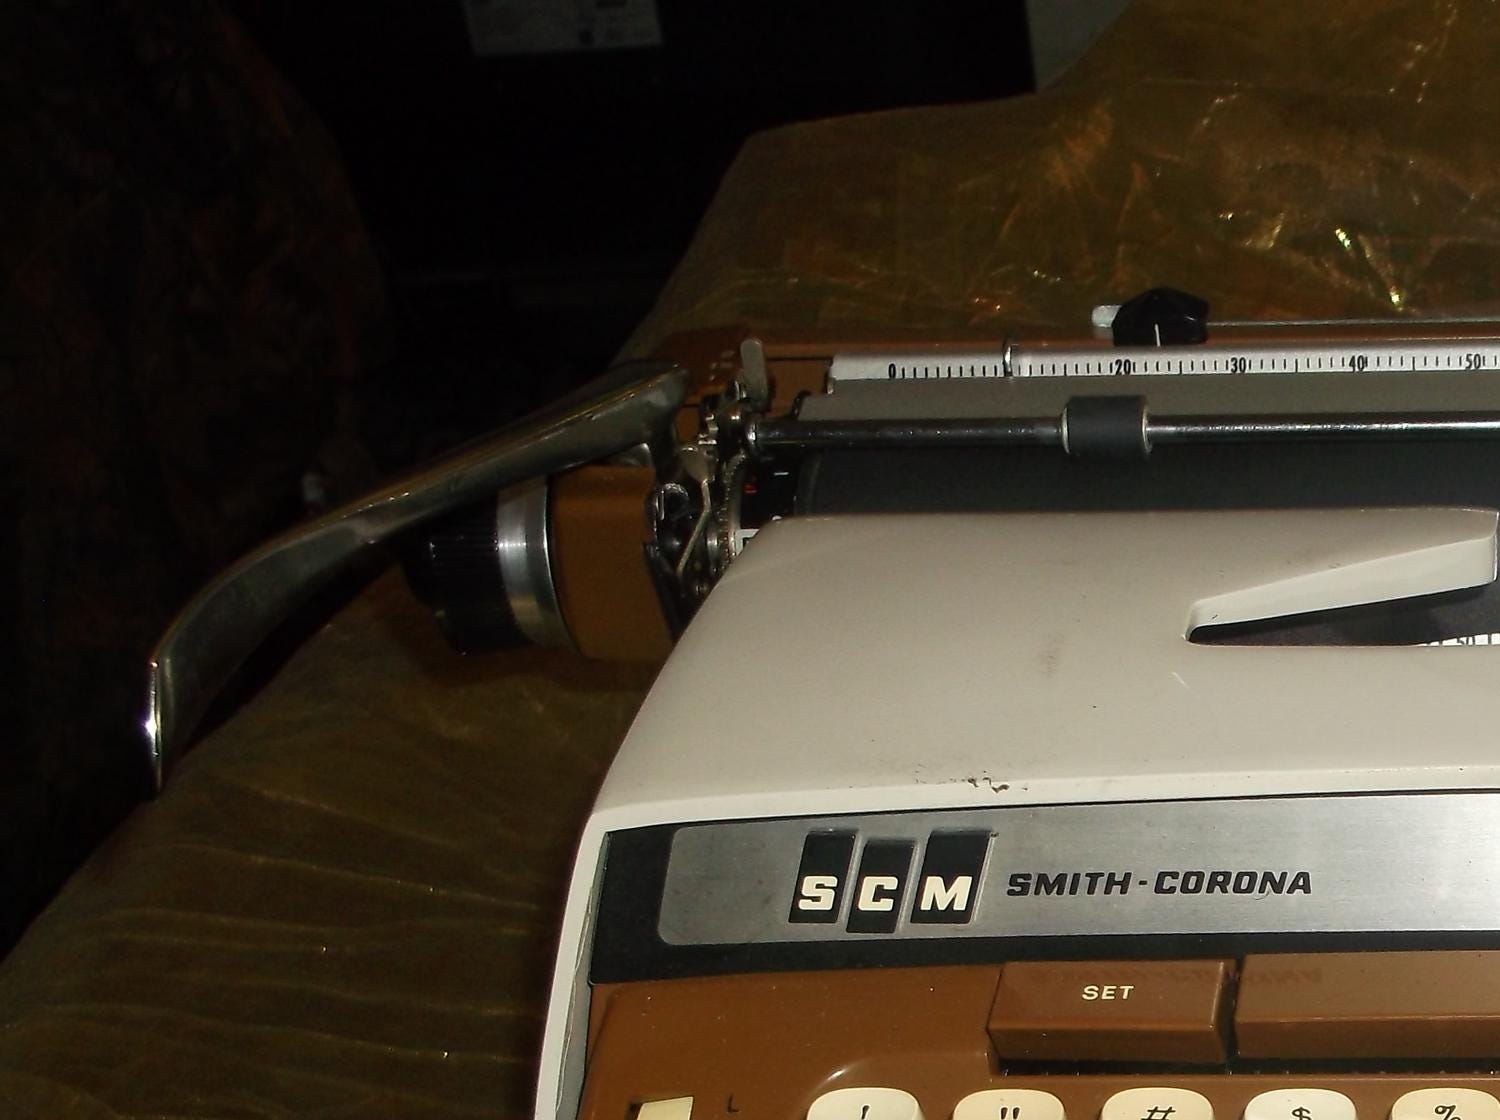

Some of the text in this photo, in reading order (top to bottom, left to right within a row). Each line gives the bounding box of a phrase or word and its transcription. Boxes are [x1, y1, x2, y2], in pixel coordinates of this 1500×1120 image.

[888, 363, 896, 379] 0
[1114, 358, 1131, 375] 20
[1230, 356, 1247, 373] 30
[1348, 354, 1364, 372] 40
[1465, 353, 1481, 370] 50
[799, 875, 972, 912] SCM
[1081, 985, 1134, 1000] SET
[726, 1094, 740, 1114] L
